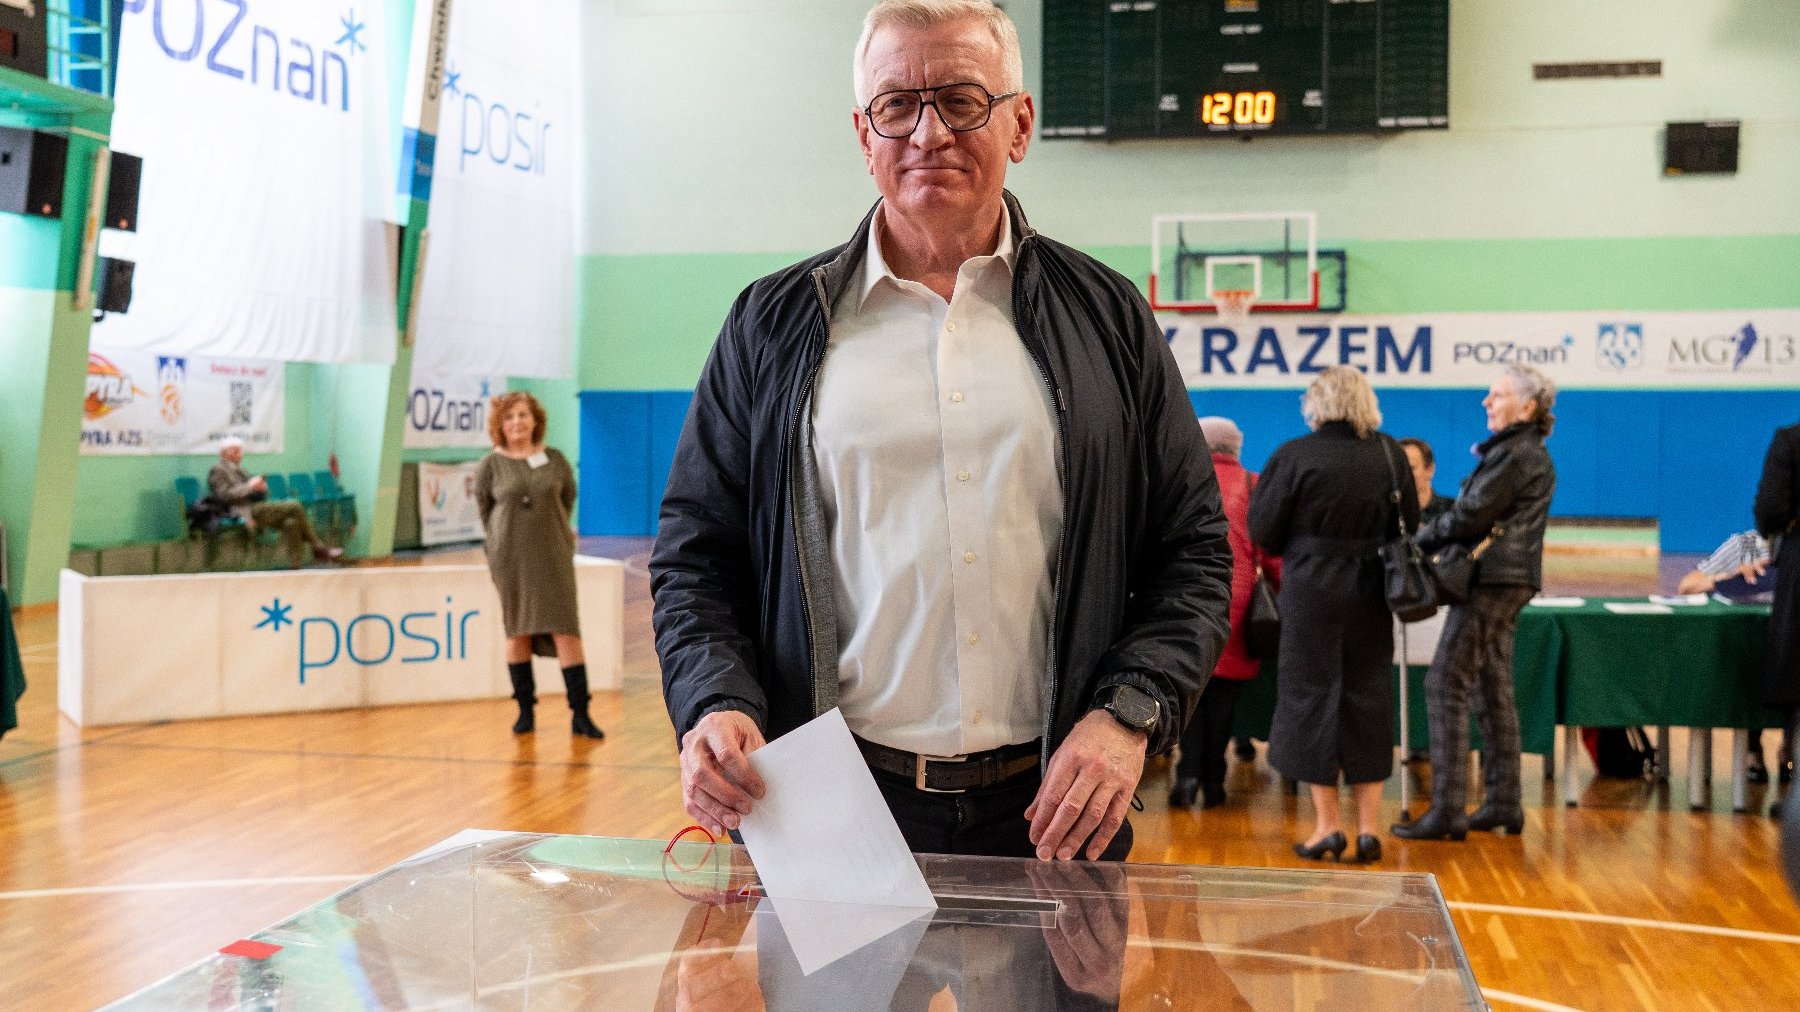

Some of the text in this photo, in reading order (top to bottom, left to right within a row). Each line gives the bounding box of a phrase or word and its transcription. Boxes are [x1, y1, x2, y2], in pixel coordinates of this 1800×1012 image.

[460, 92, 551, 175] posir
[1201, 326, 1431, 374] RAZEM
[299, 596, 479, 684] posir
